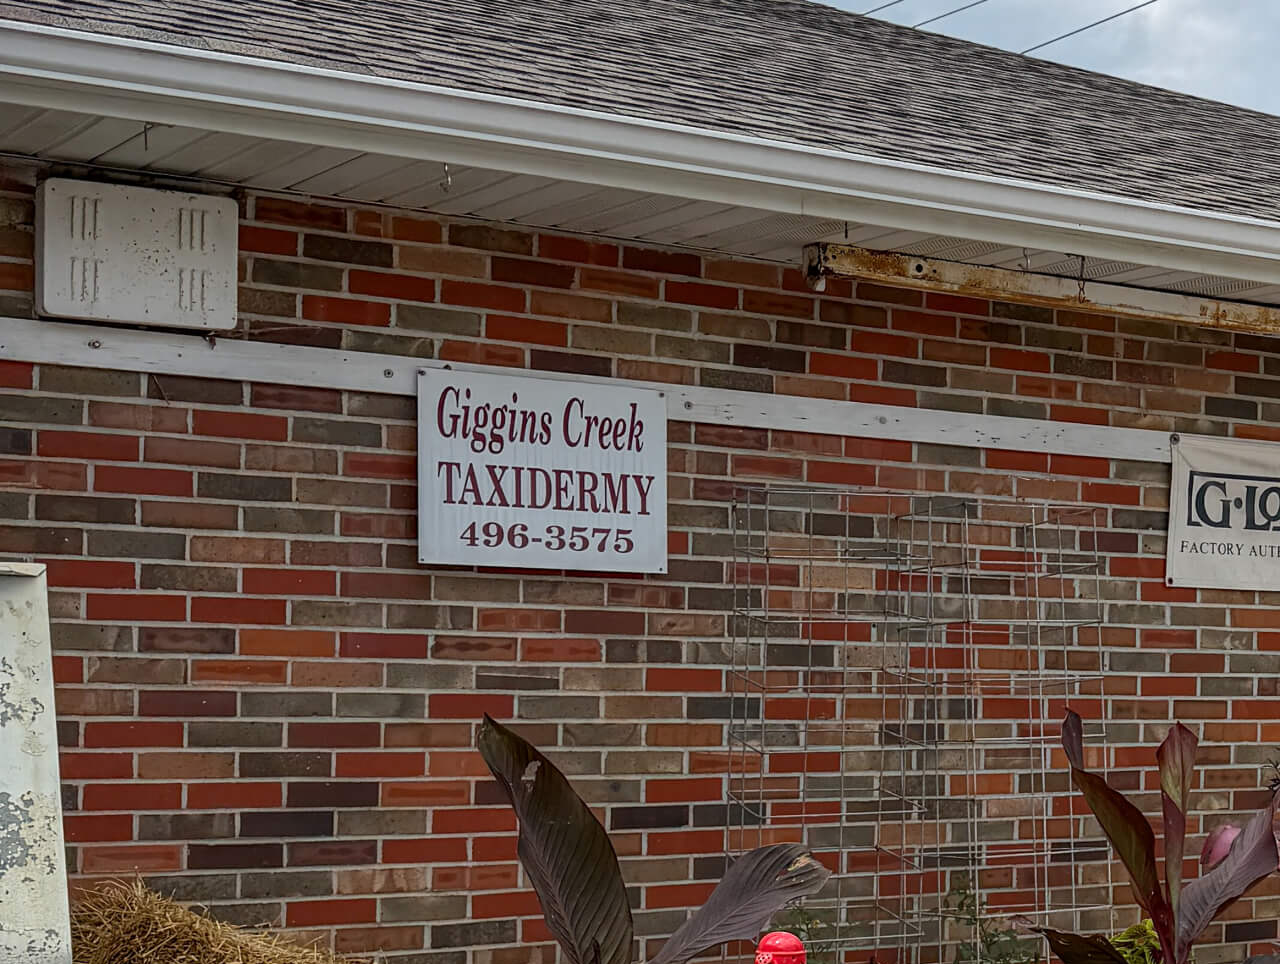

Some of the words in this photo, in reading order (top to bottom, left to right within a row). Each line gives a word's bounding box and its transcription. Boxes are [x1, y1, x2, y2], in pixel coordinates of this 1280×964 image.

[437, 386, 552, 454] Giggins
[563, 397, 645, 452] Creek
[437, 460, 656, 516] TAXIDERMY
[460, 521, 635, 554] 496-3575
[1180, 540, 1245, 557] FACTORY
